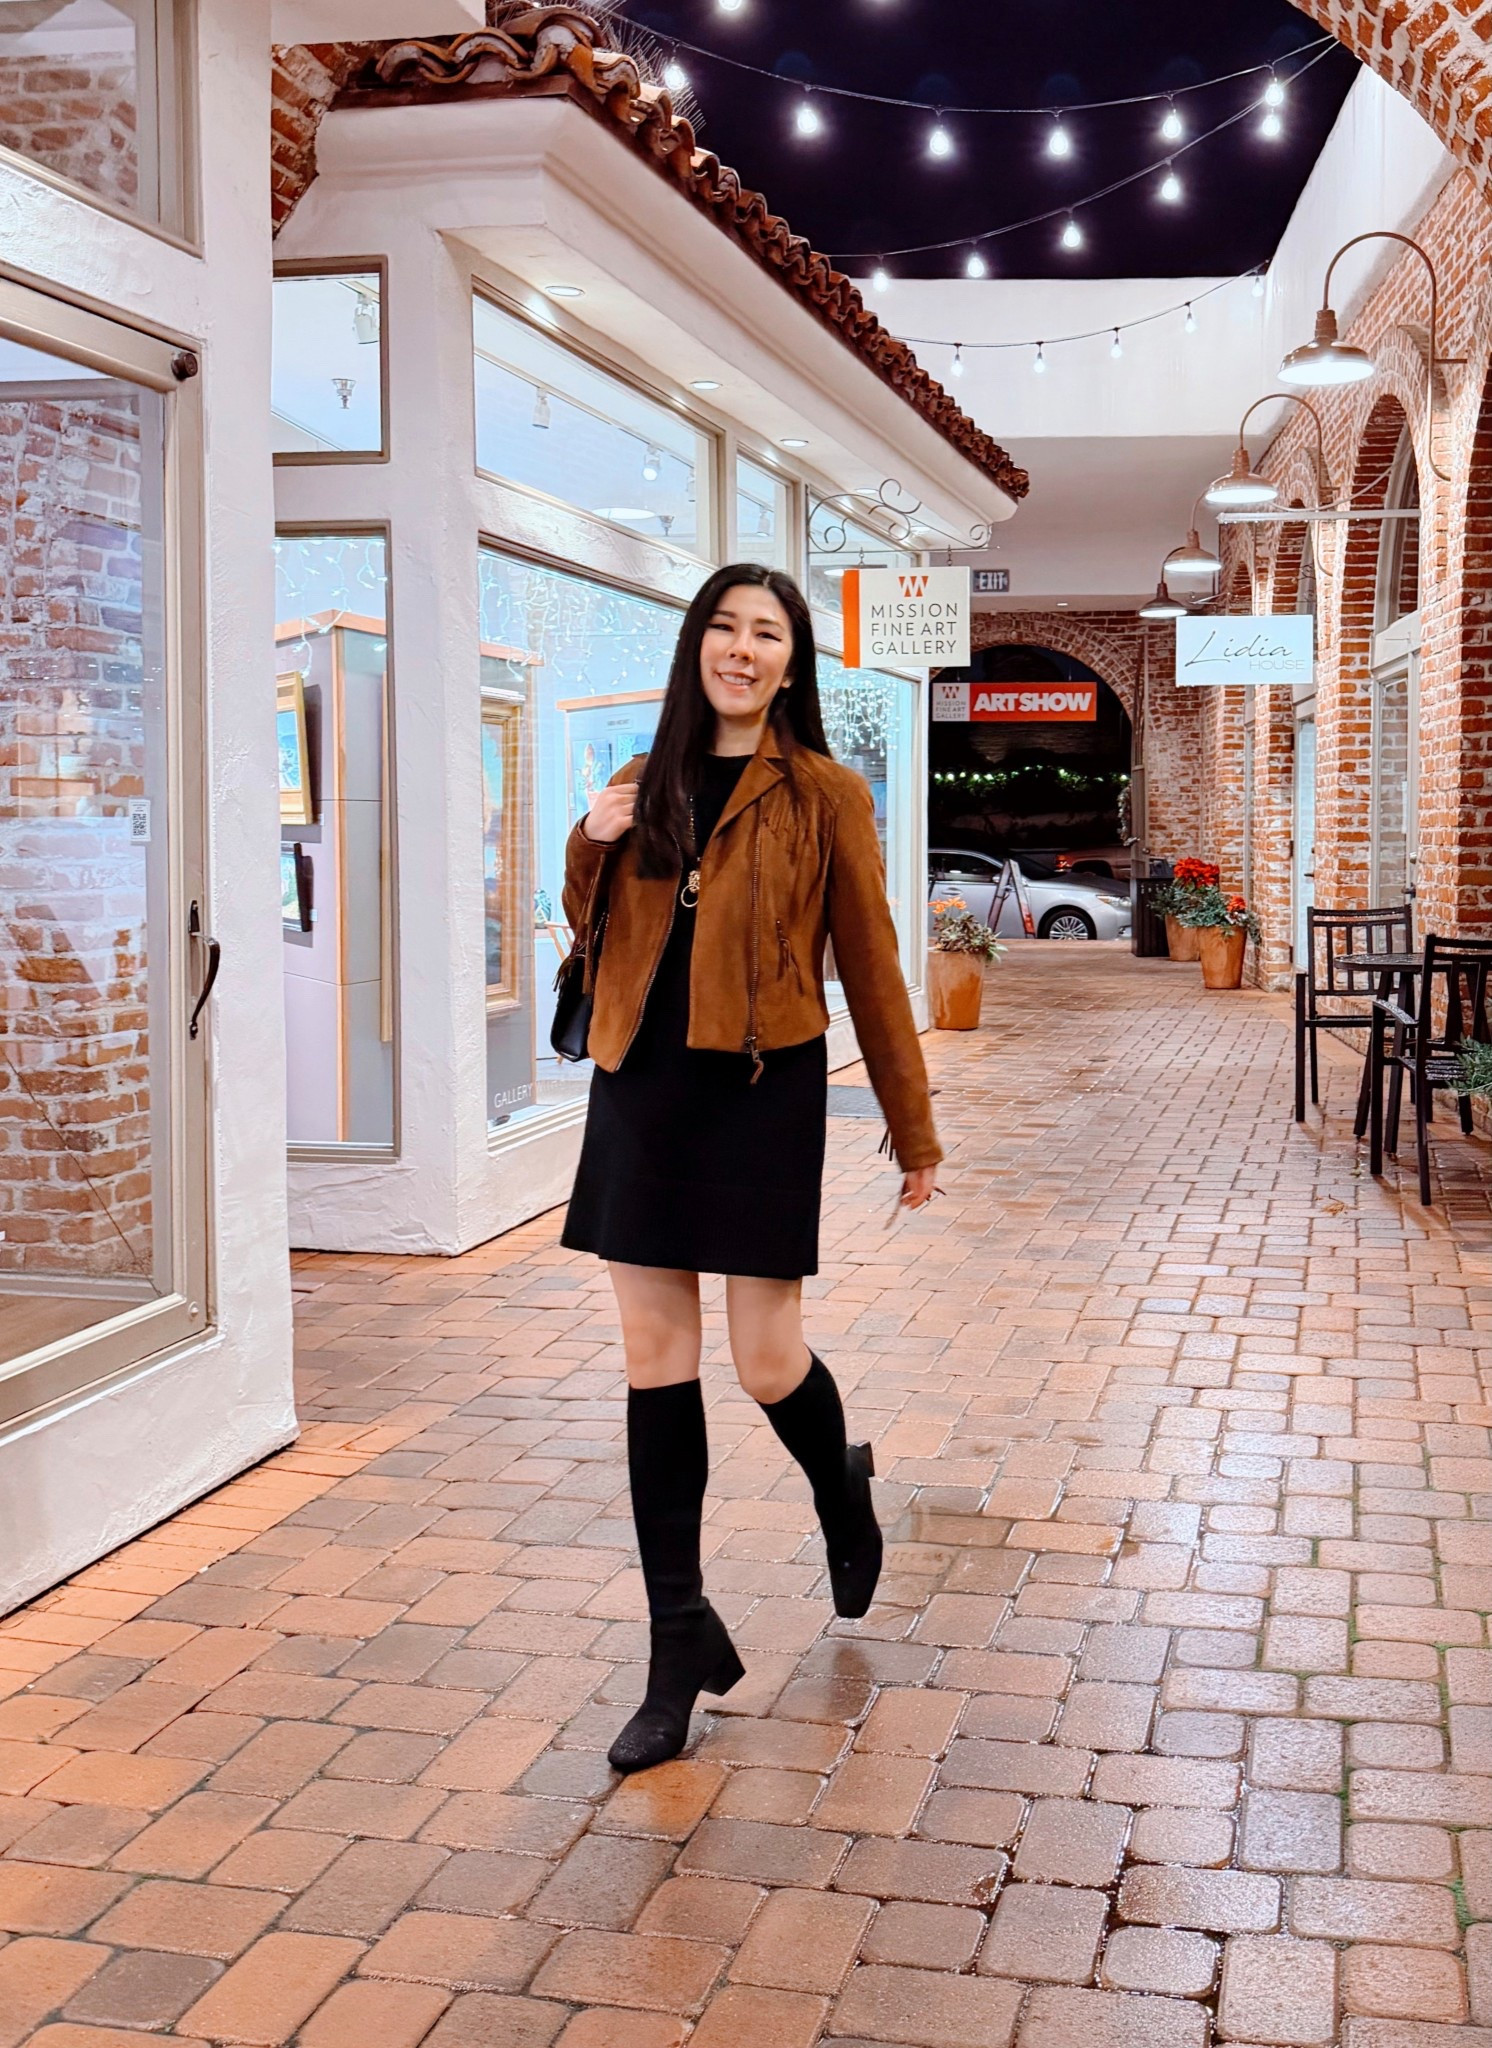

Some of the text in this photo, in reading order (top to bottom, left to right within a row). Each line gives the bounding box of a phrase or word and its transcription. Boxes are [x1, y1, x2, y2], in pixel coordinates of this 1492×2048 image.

[980, 572, 1005, 590] EXIT
[871, 603, 958, 619] MISSION
[871, 621, 958, 637] FINE ART
[871, 640, 958, 655] GALLERY
[1184, 630, 1293, 668] Lidia
[1249, 659, 1305, 671] HOUSE
[494, 1084, 533, 1108] GALLERY
